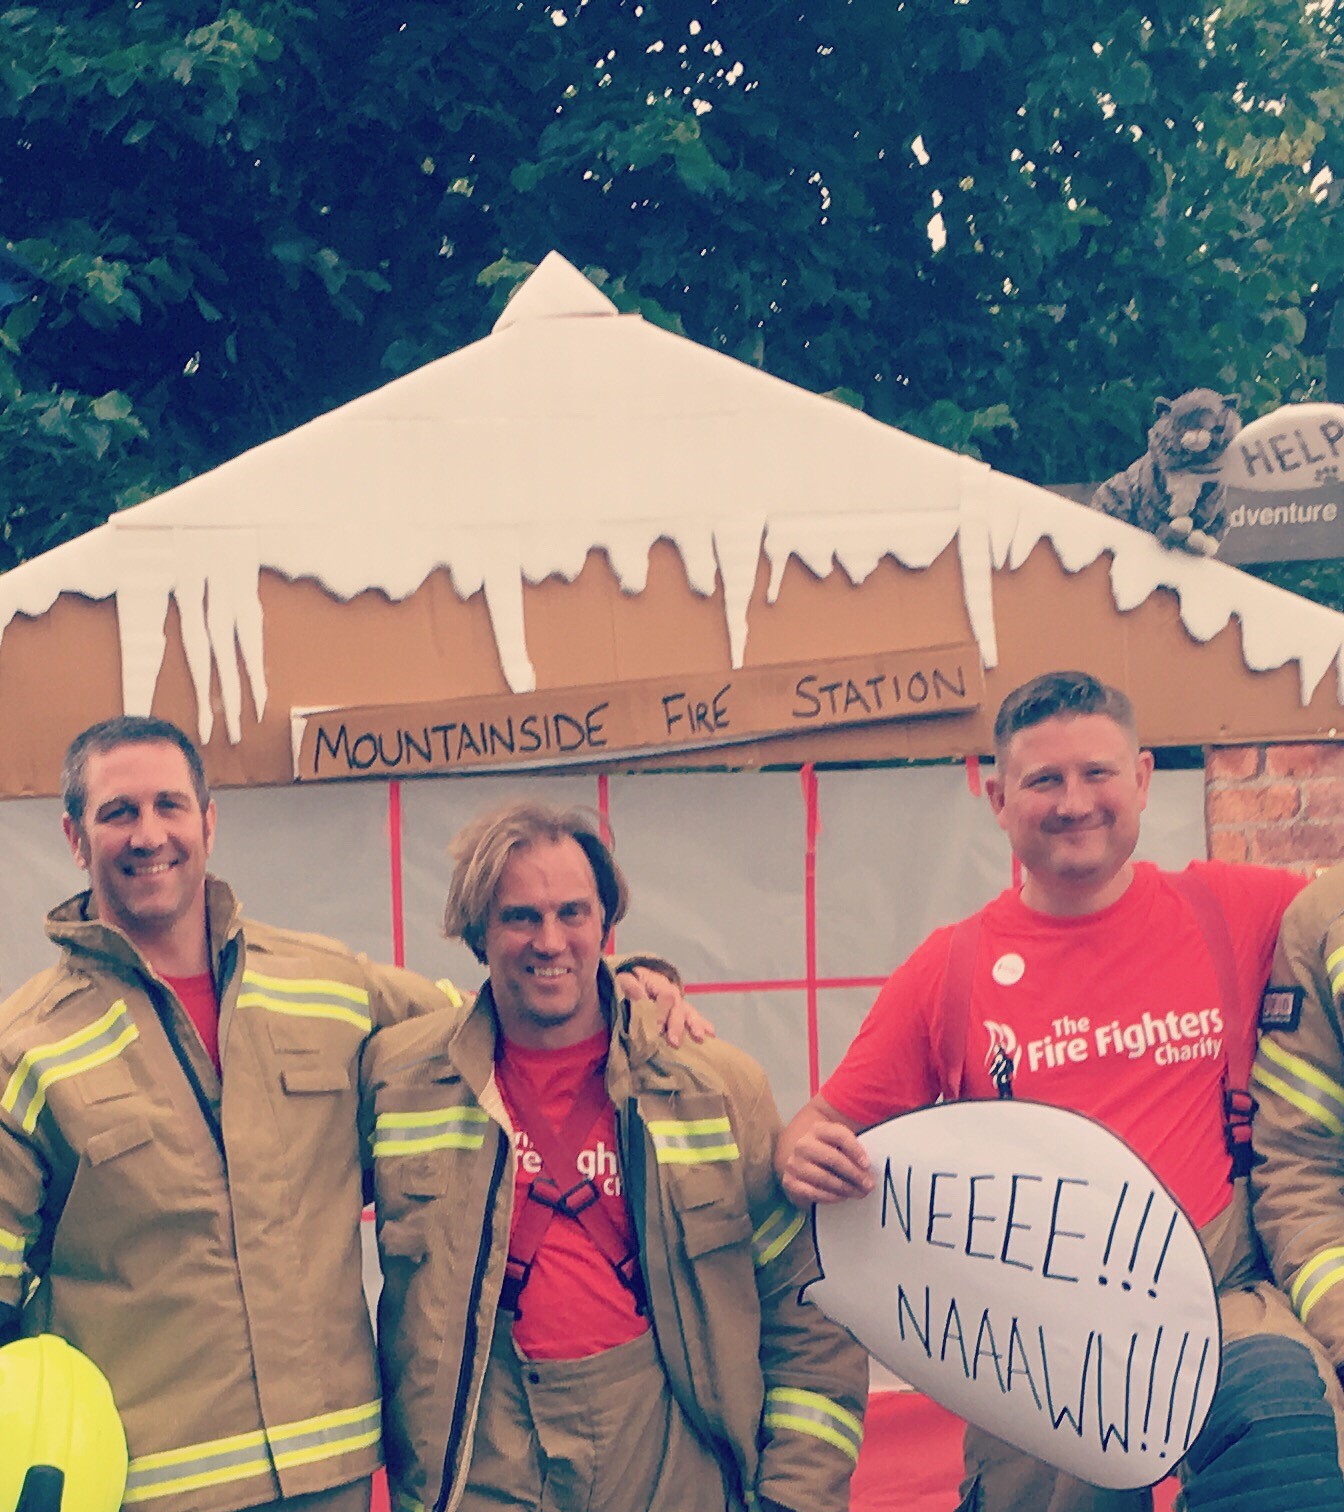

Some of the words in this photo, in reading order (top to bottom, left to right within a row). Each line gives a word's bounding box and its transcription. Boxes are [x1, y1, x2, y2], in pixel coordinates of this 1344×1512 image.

[1230, 502, 1338, 528] dventure
[314, 702, 609, 774] MOUNTAINSIDE
[661, 683, 732, 736] FIRE
[792, 666, 966, 719] STATION
[1027, 1035, 1089, 1072] Fire
[1095, 1008, 1224, 1059] Fighters
[1052, 1015, 1090, 1039] The
[1155, 1036, 1224, 1066] Charity
[881, 1156, 1178, 1299] NEEEE!!!
